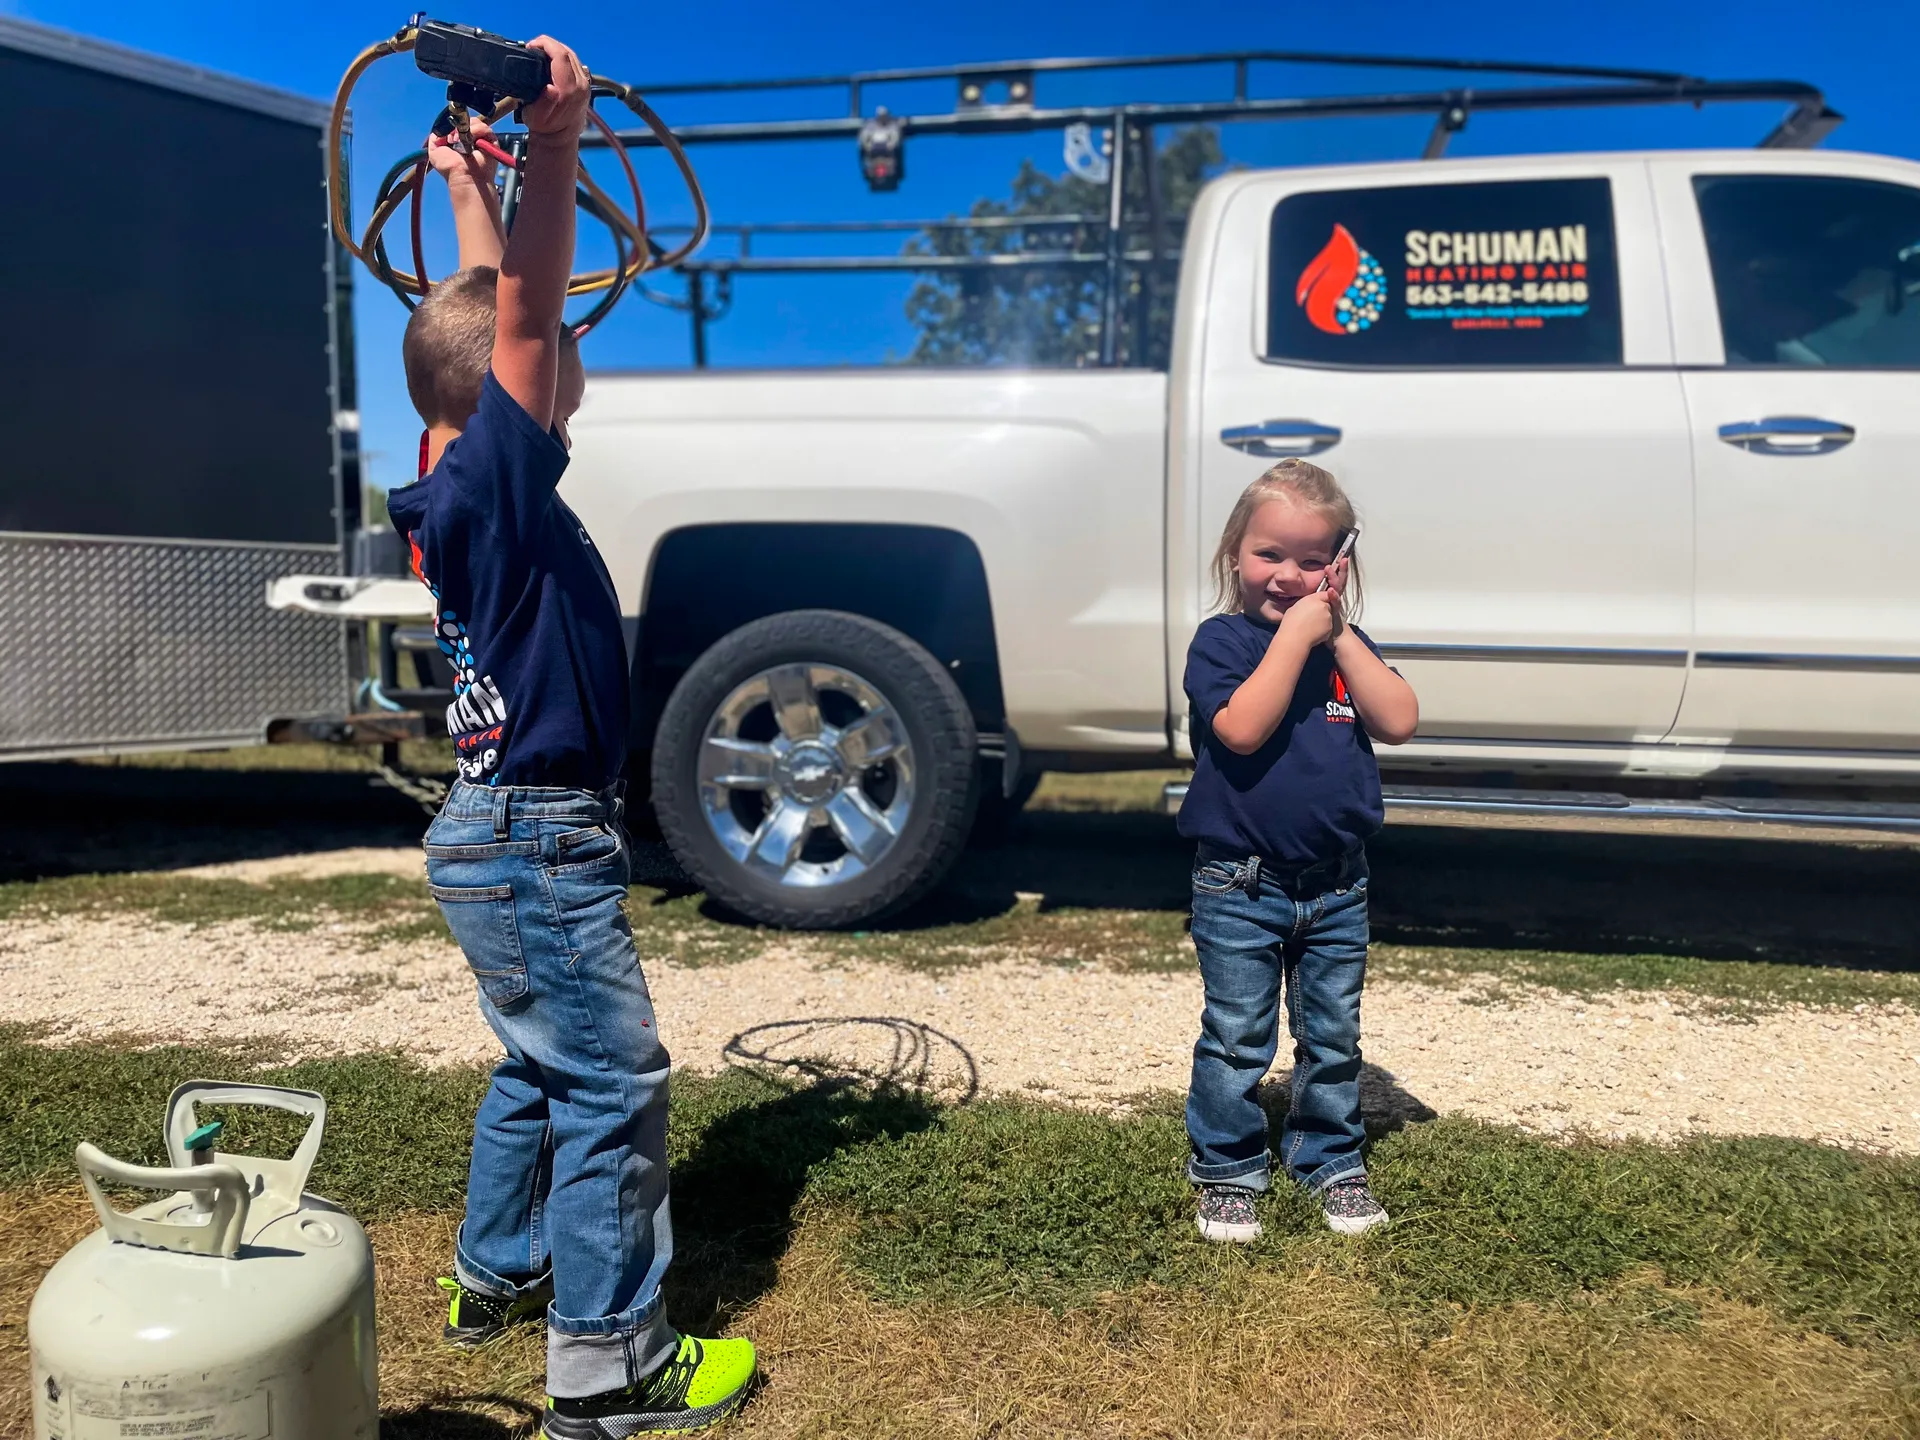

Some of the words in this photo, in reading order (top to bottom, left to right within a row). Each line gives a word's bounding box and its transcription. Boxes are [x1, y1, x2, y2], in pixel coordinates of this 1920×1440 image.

[1405, 224, 1587, 266] SCHUMAN
[1406, 265, 1516, 282] HEATING
[1542, 263, 1586, 280] AIR
[446, 675, 506, 735] MAN
